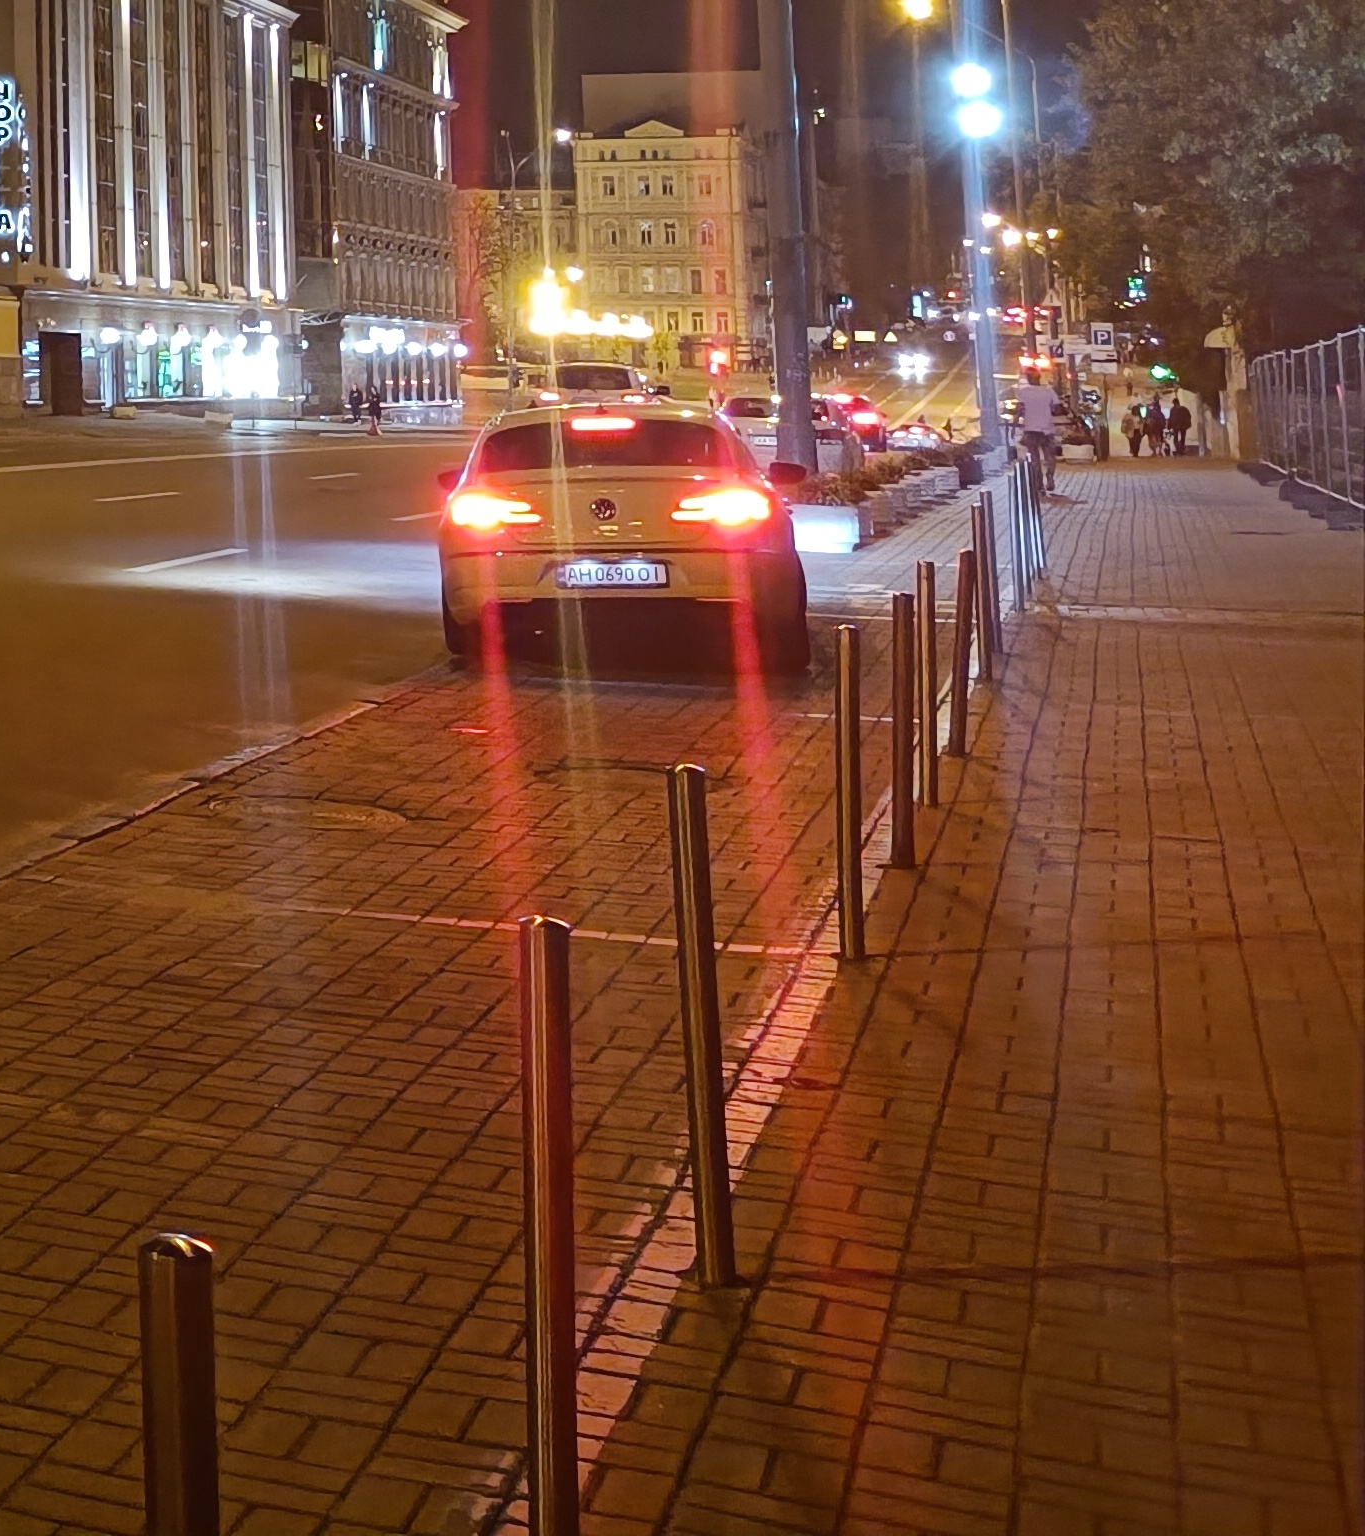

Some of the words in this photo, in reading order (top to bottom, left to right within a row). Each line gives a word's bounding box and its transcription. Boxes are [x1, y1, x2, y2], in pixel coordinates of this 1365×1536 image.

[1096, 331, 1109, 345] P
[568, 567, 592, 582] AH
[595, 567, 634, 582] 0690
